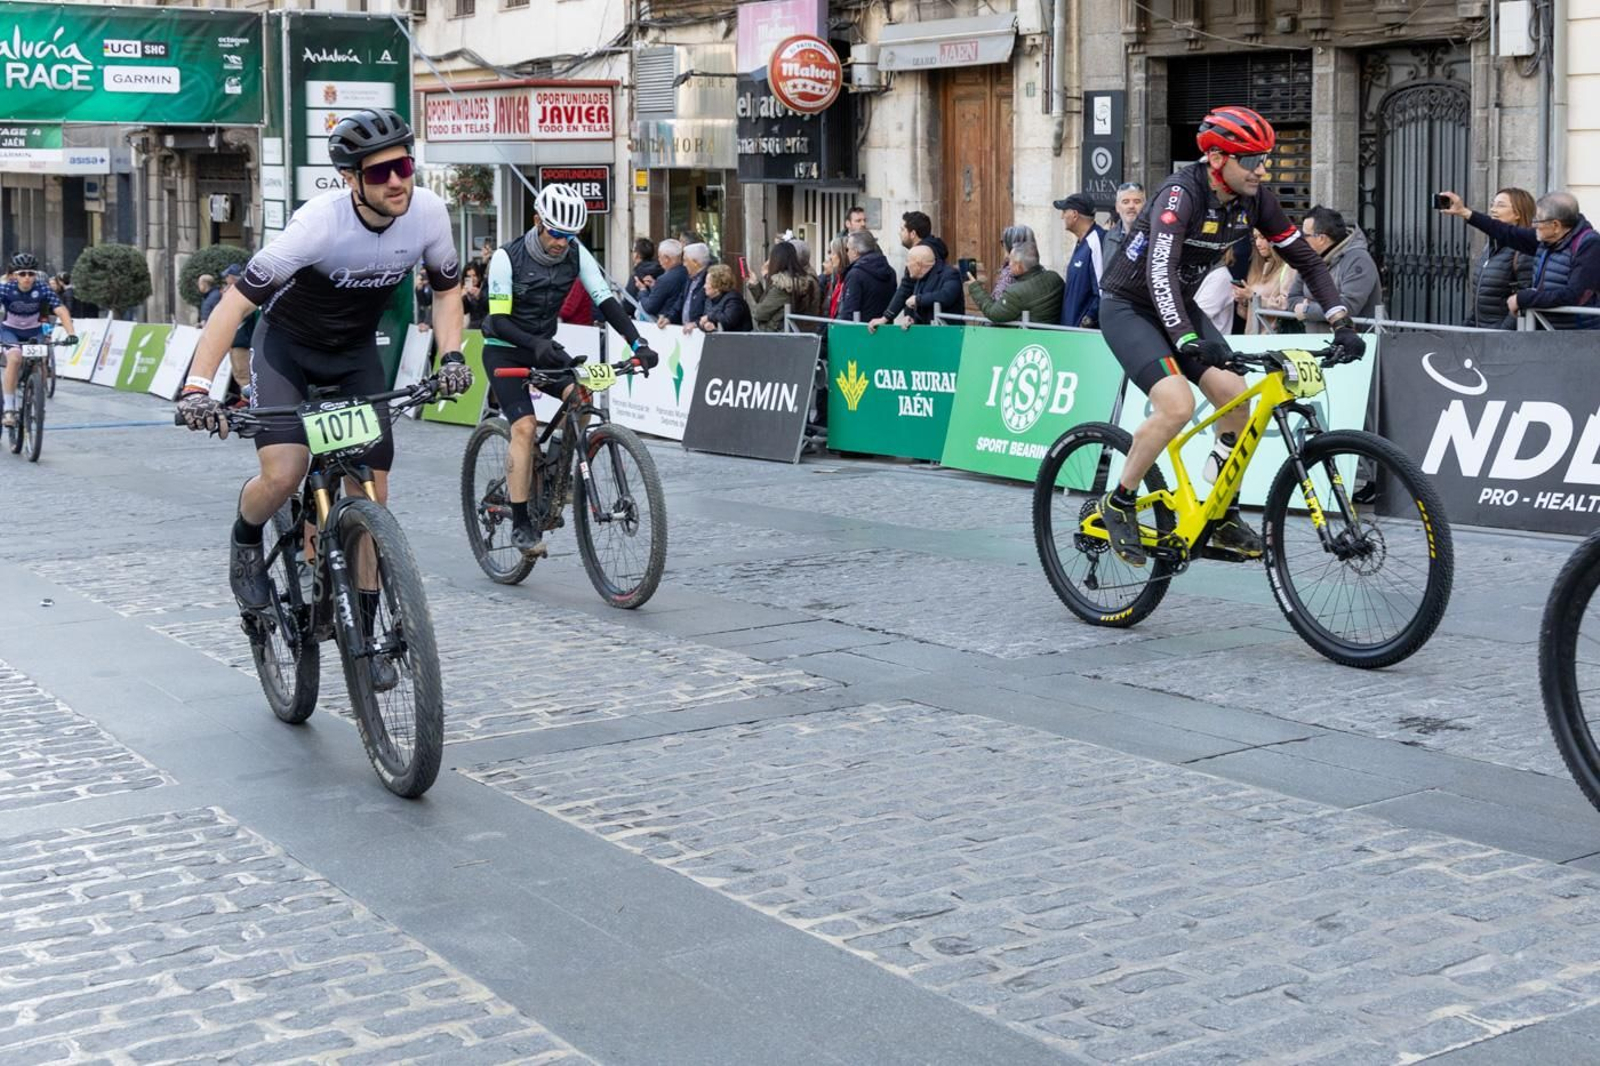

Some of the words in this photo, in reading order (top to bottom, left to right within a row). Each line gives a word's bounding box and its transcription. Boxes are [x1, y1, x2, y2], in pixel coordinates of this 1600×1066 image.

[111, 43, 138, 54] UCI
[144, 44, 165, 54] SHC
[302, 47, 362, 64] Andalucía
[5, 62, 94, 91] RACE
[113, 73, 172, 85] GARMIN
[781, 62, 836, 80] Mahou
[536, 92, 609, 104] OPORTUNIDADES
[427, 96, 489, 122] OPORTUNIDADES
[493, 95, 530, 135] JAVIER
[538, 105, 609, 124] JAVIER
[0, 128, 27, 136] AGE
[428, 125, 449, 134] TODO
[451, 124, 462, 133] EN
[465, 123, 490, 133] TELAS
[538, 125, 563, 133] TODO
[582, 124, 610, 132] TELAS
[1152, 232, 1183, 328] CORRECAMINOSBIKE
[588, 364, 611, 378] 637
[874, 369, 908, 390] CAJA
[1298, 361, 1322, 382] 673
[899, 393, 934, 417] JAÉN
[315, 408, 369, 445] 1071
[976, 436, 1009, 454] SPORT
[1009, 441, 1052, 459] BEARIN
[1206, 417, 1259, 519] SCOTT
[1478, 488, 1519, 506] PRO
[1534, 492, 1600, 513] HEALT
